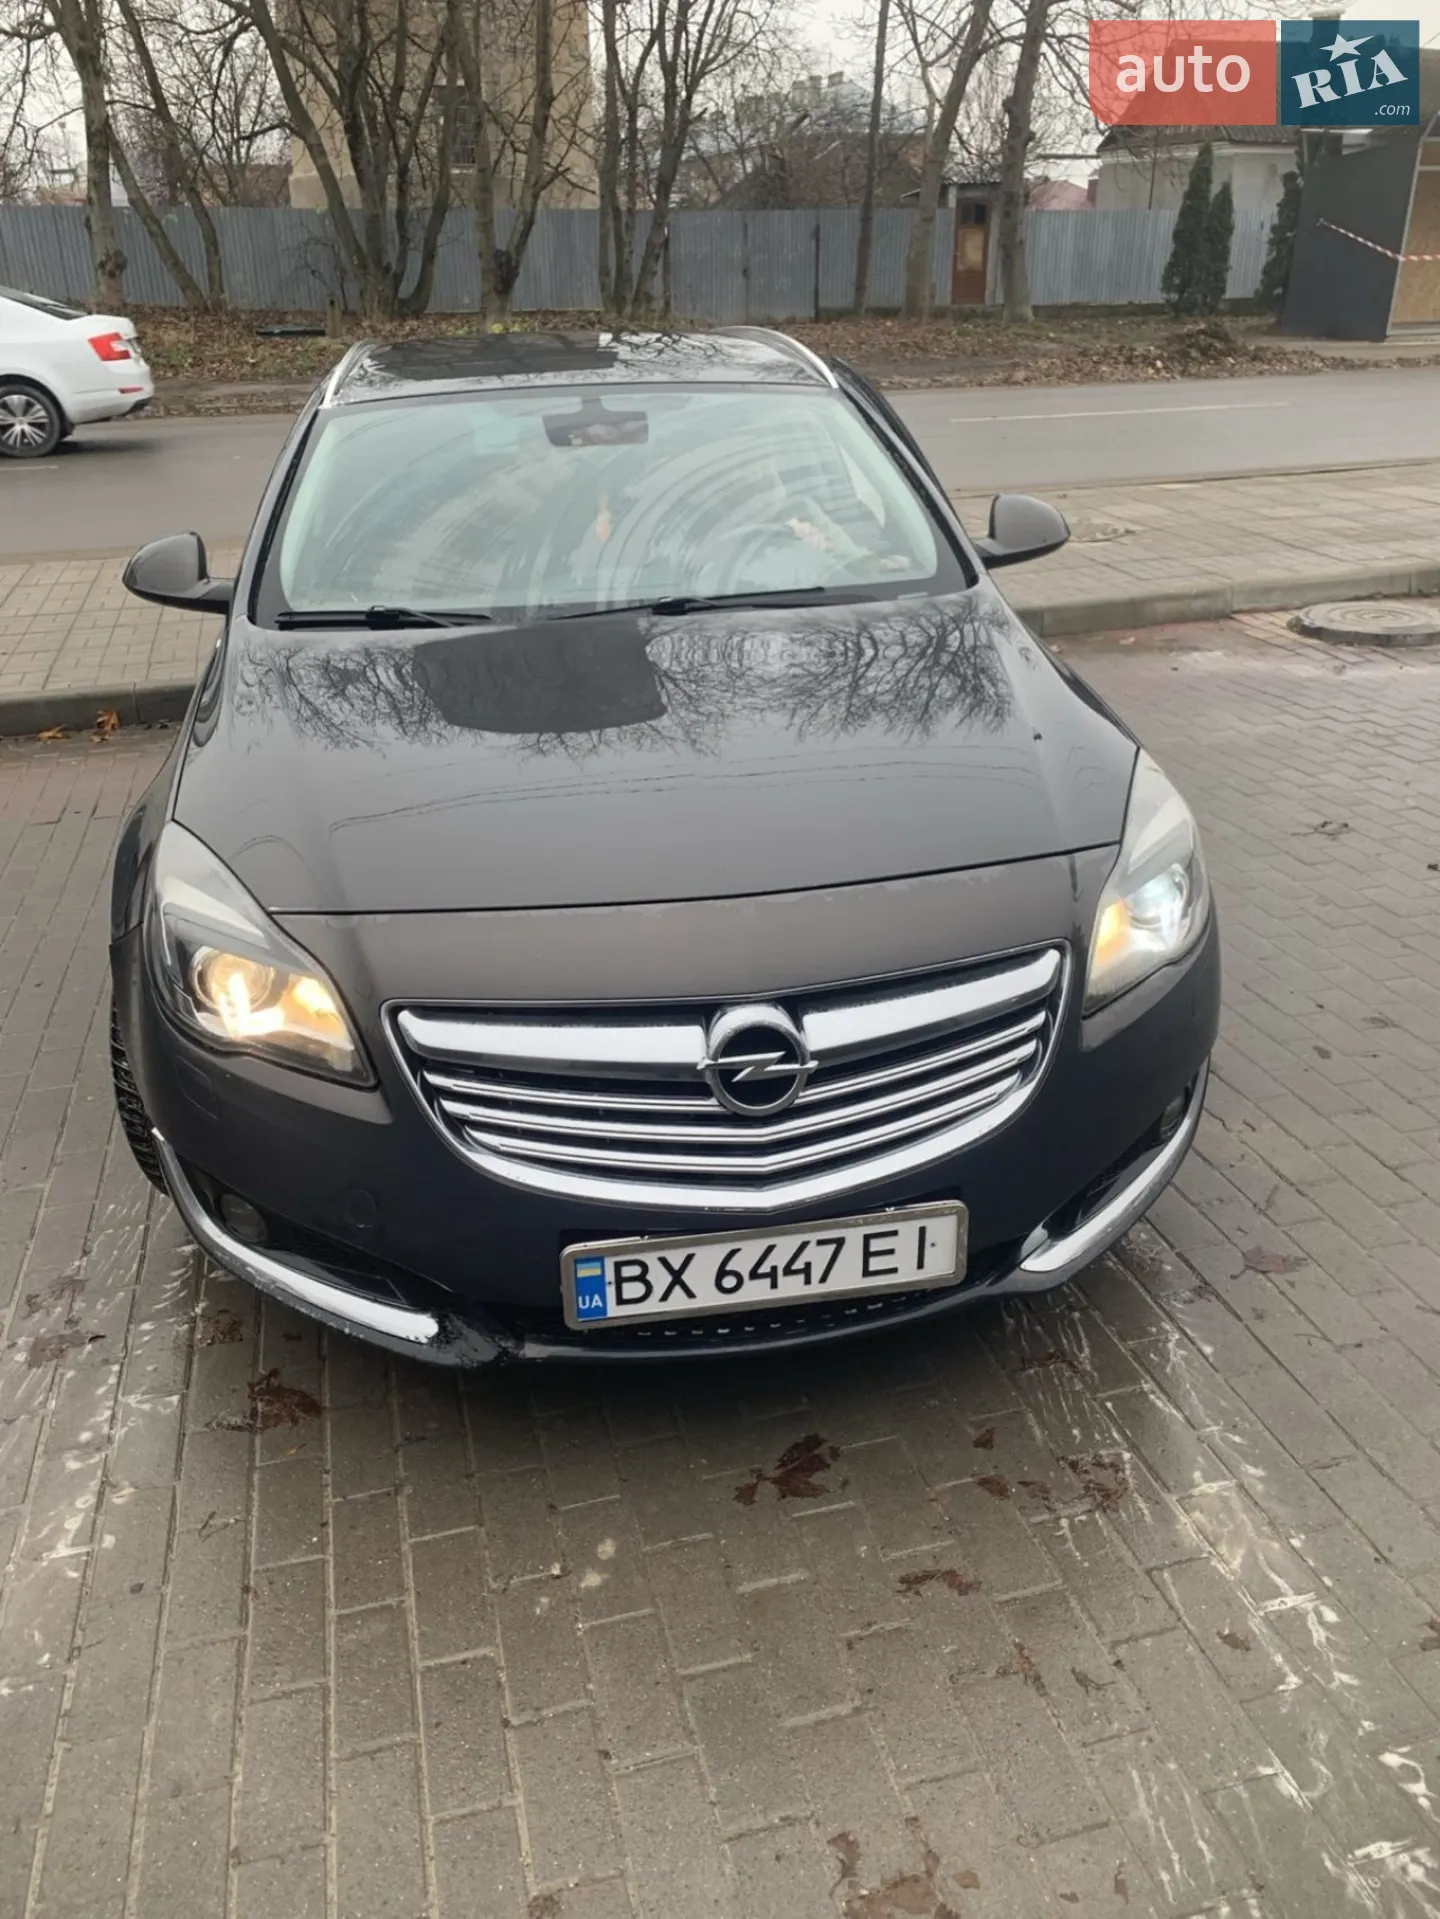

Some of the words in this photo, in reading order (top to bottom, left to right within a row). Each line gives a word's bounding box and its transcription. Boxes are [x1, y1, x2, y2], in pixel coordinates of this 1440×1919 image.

[613, 1253, 697, 1306] BX
[714, 1236, 846, 1295] 6447
[578, 1295, 604, 1309] UA
